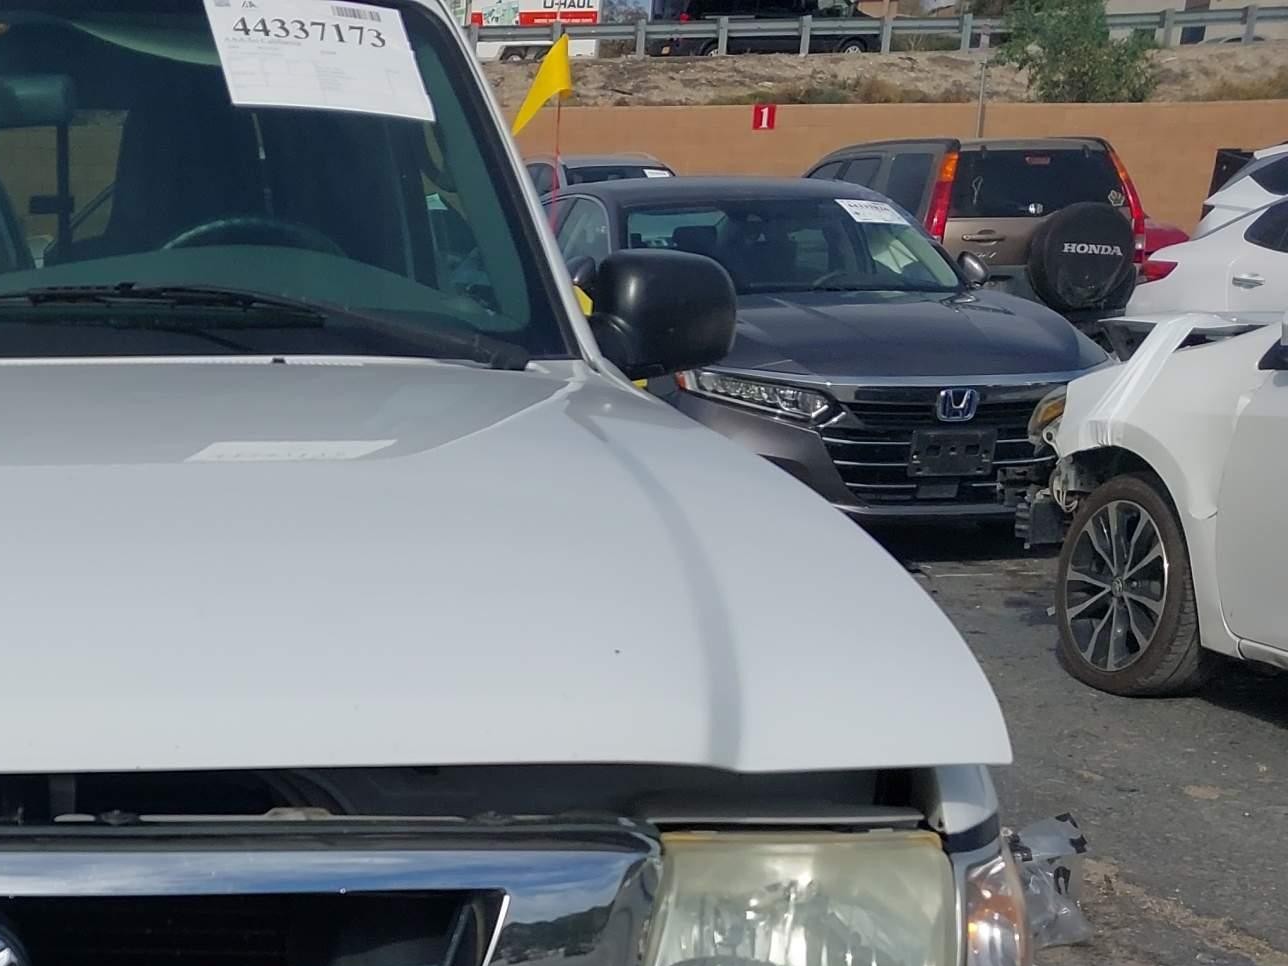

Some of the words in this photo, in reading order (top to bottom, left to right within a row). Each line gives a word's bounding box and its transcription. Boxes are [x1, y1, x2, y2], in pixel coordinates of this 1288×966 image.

[232, 16, 387, 48] 44337173
[761, 107, 769, 128] 1
[1063, 243, 1123, 256] HONDA
